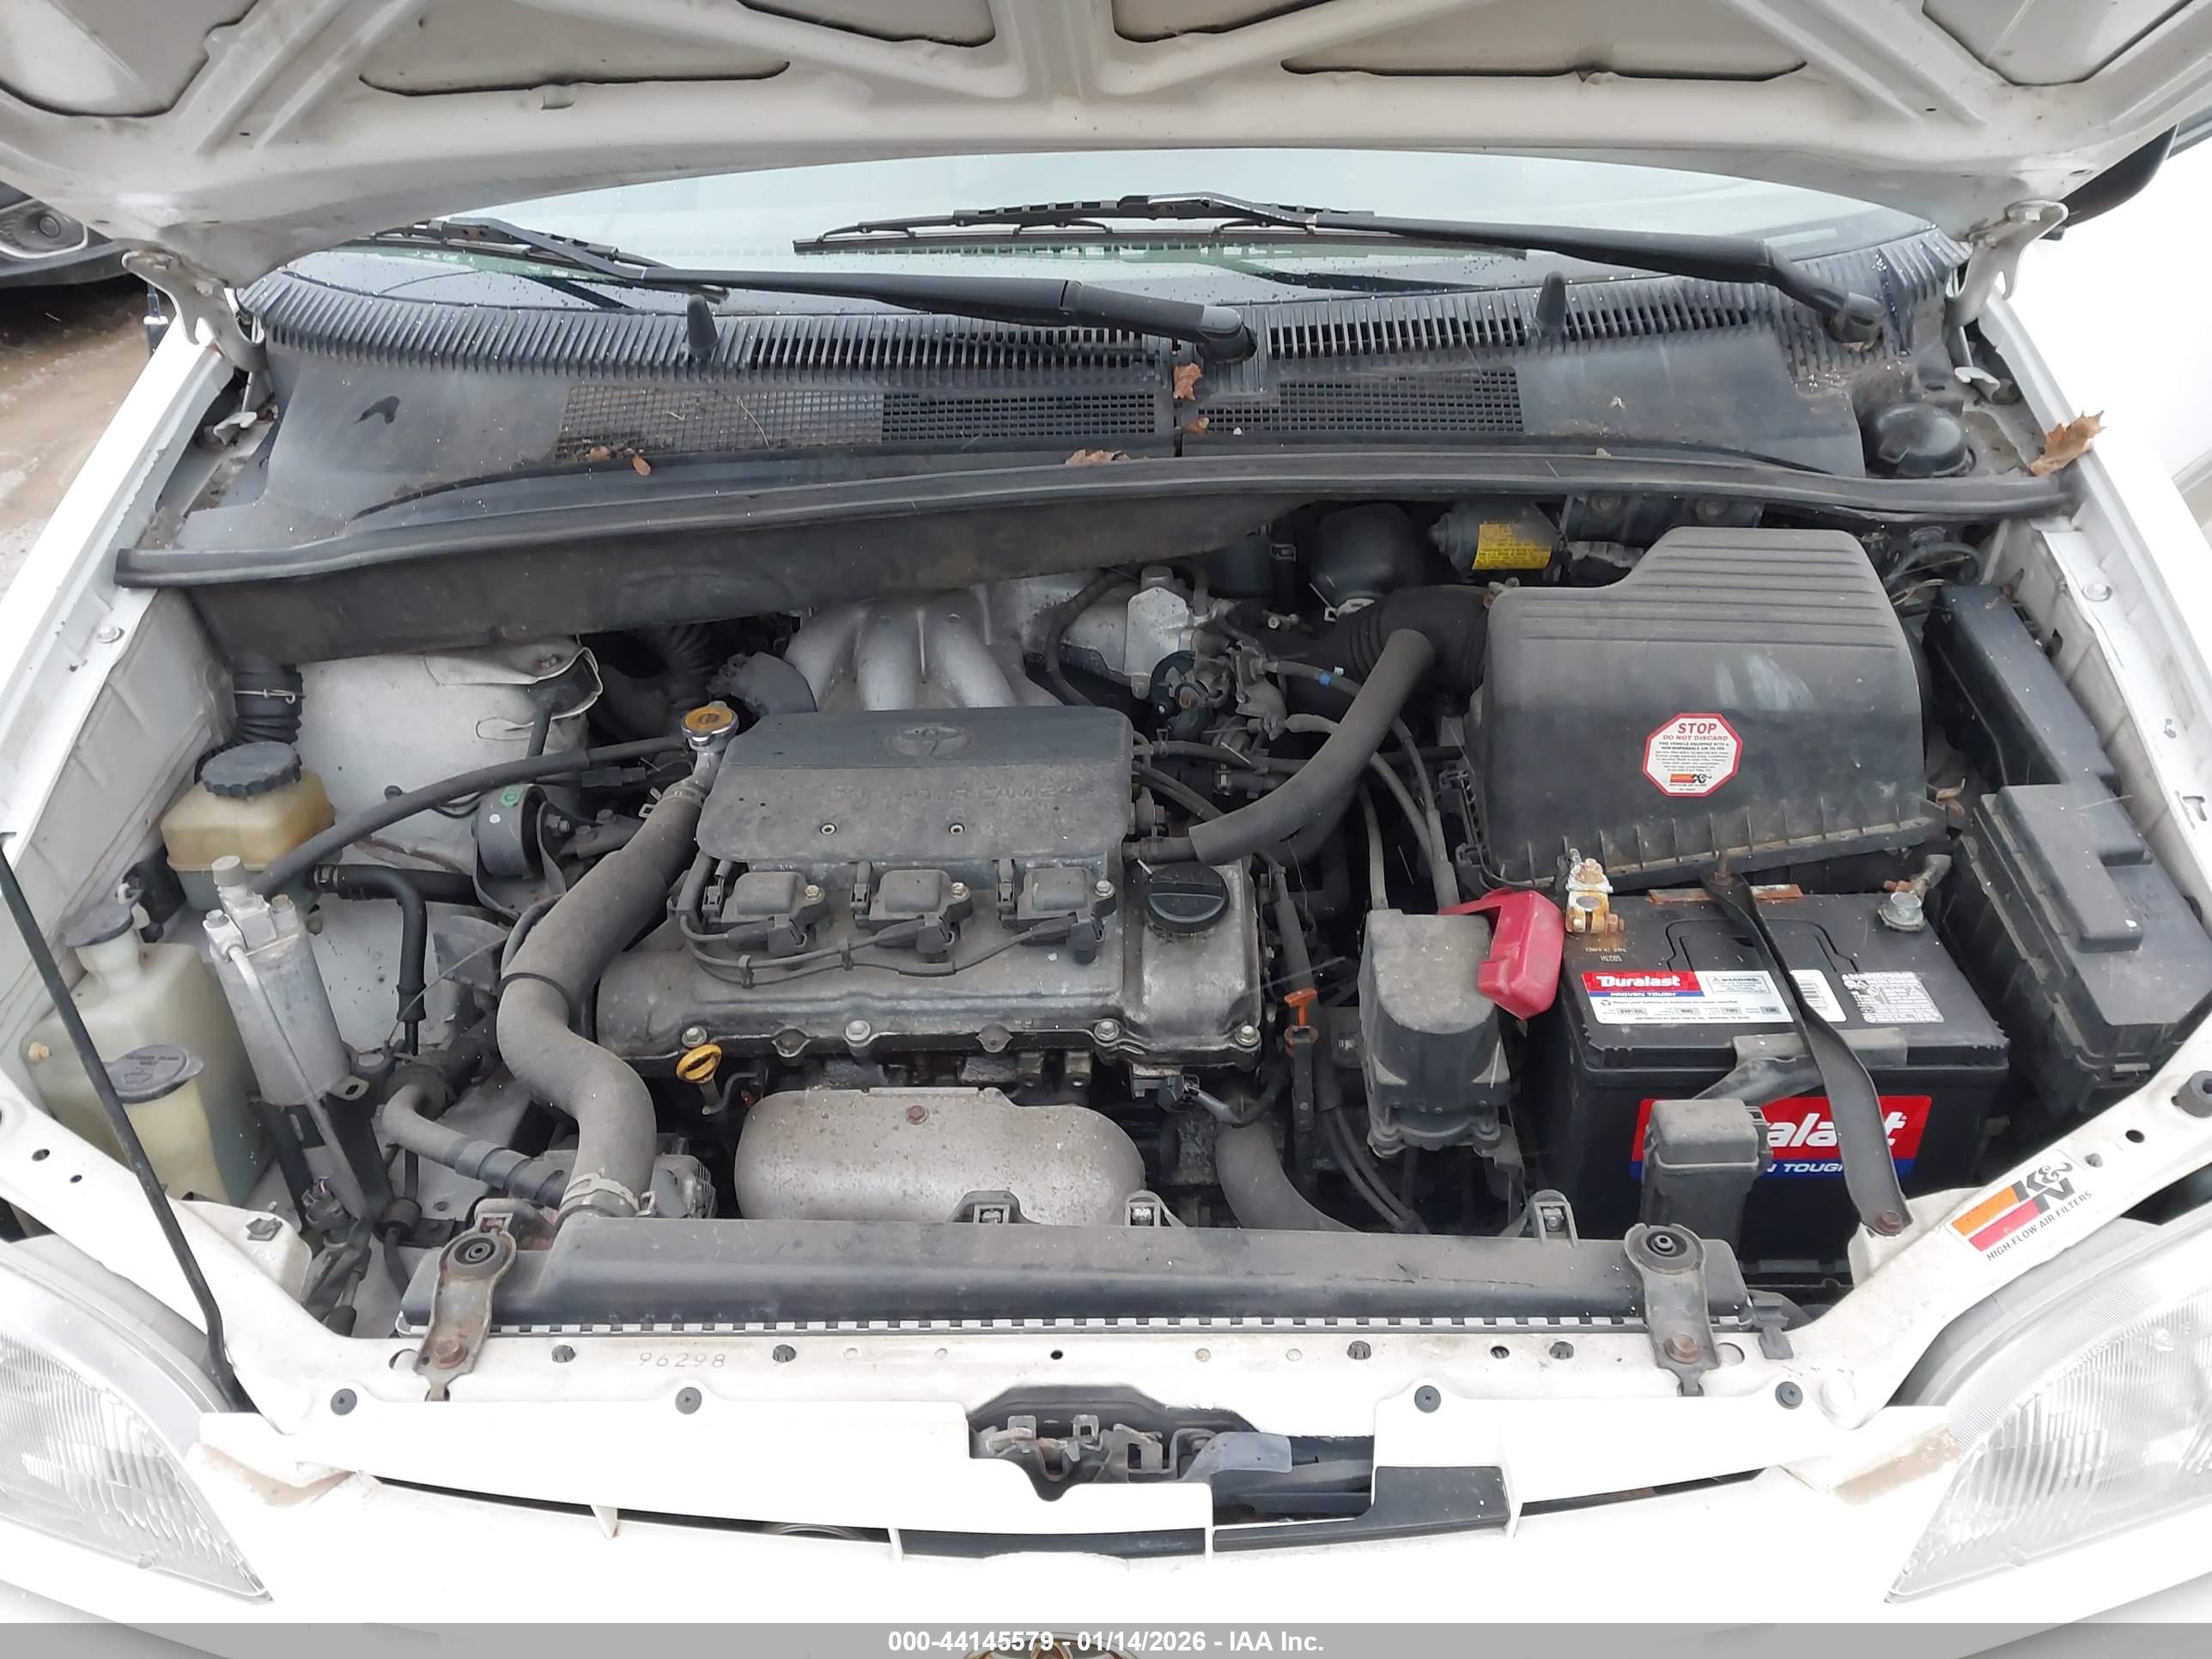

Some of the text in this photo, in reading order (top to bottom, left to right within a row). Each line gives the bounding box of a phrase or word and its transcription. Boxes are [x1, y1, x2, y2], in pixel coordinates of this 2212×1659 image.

[1677, 722, 1717, 734] STOP
[1595, 975, 1680, 988] Duralast
[2010, 1163, 2075, 1214] K&N
[2039, 1214, 2056, 1228] AIR
[2055, 1191, 2093, 1218] FILTERS
[638, 1352, 726, 1368] 96298
